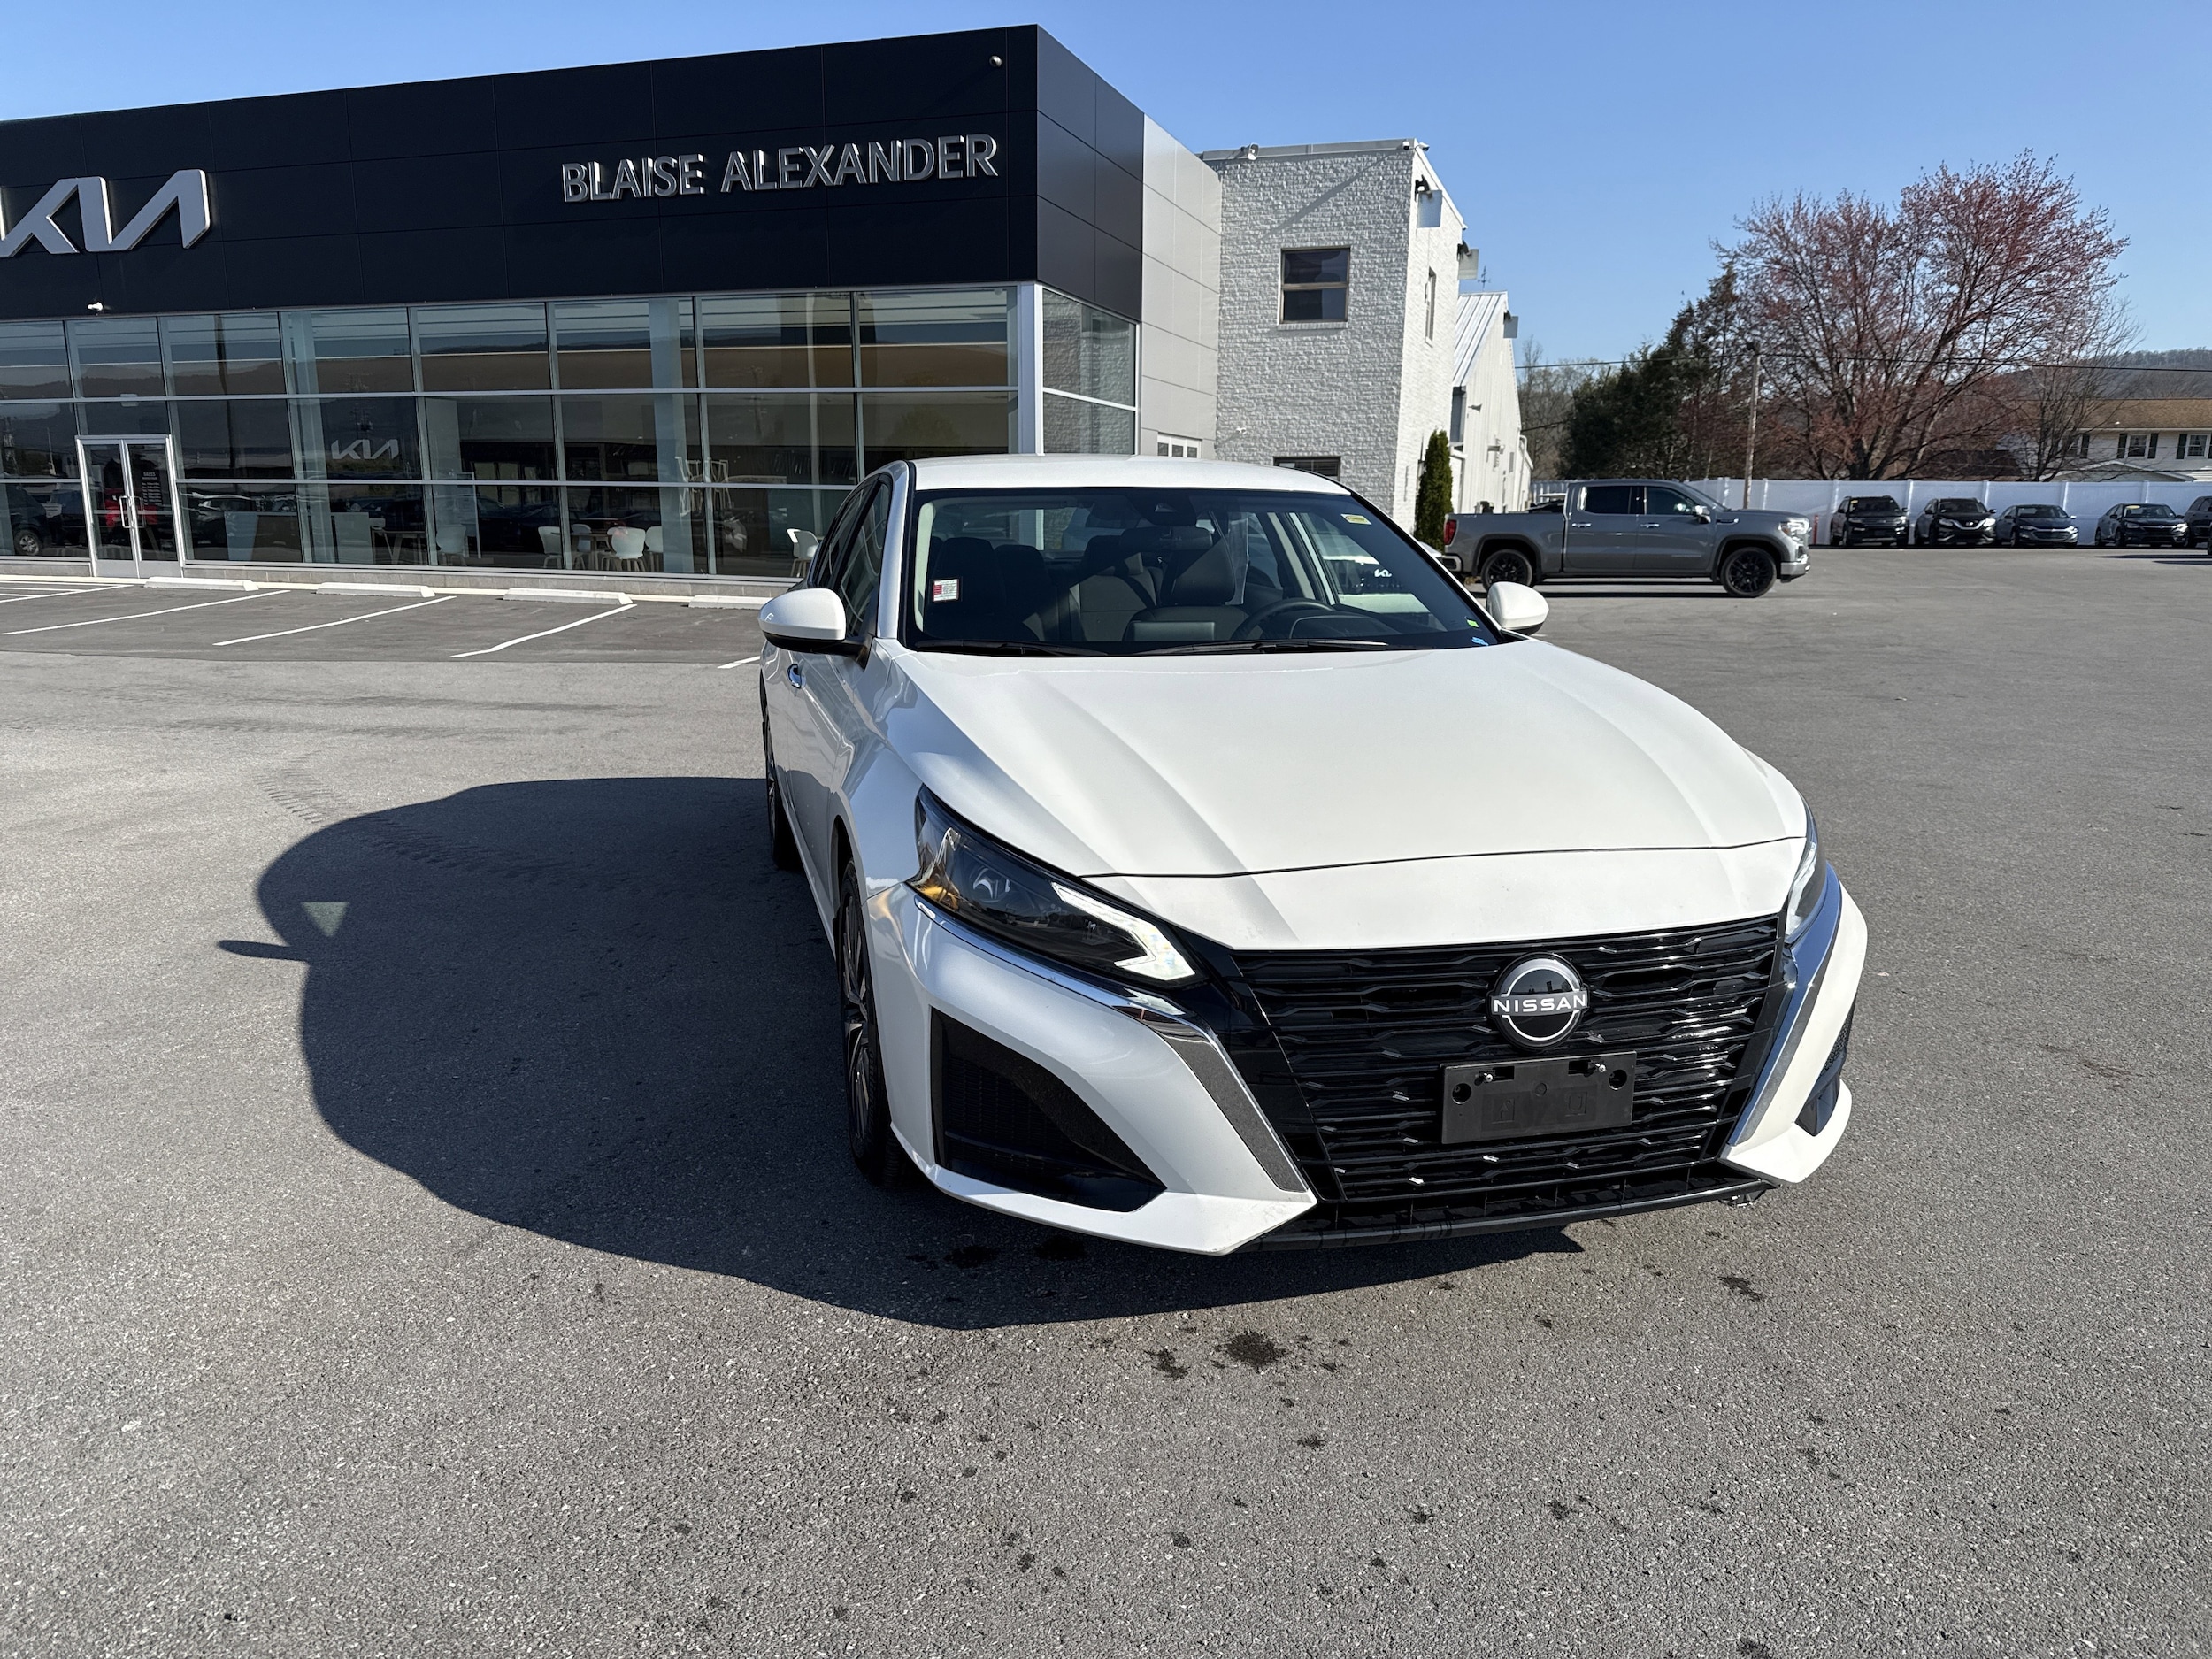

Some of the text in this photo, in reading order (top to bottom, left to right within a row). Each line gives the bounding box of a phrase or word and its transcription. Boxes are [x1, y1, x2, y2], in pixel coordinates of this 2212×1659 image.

[562, 133, 999, 203] BLAISE ALEXANDER
[0, 169, 211, 258] KIA
[331, 438, 399, 460] KIA
[1494, 994, 1586, 1013] NISSAN
